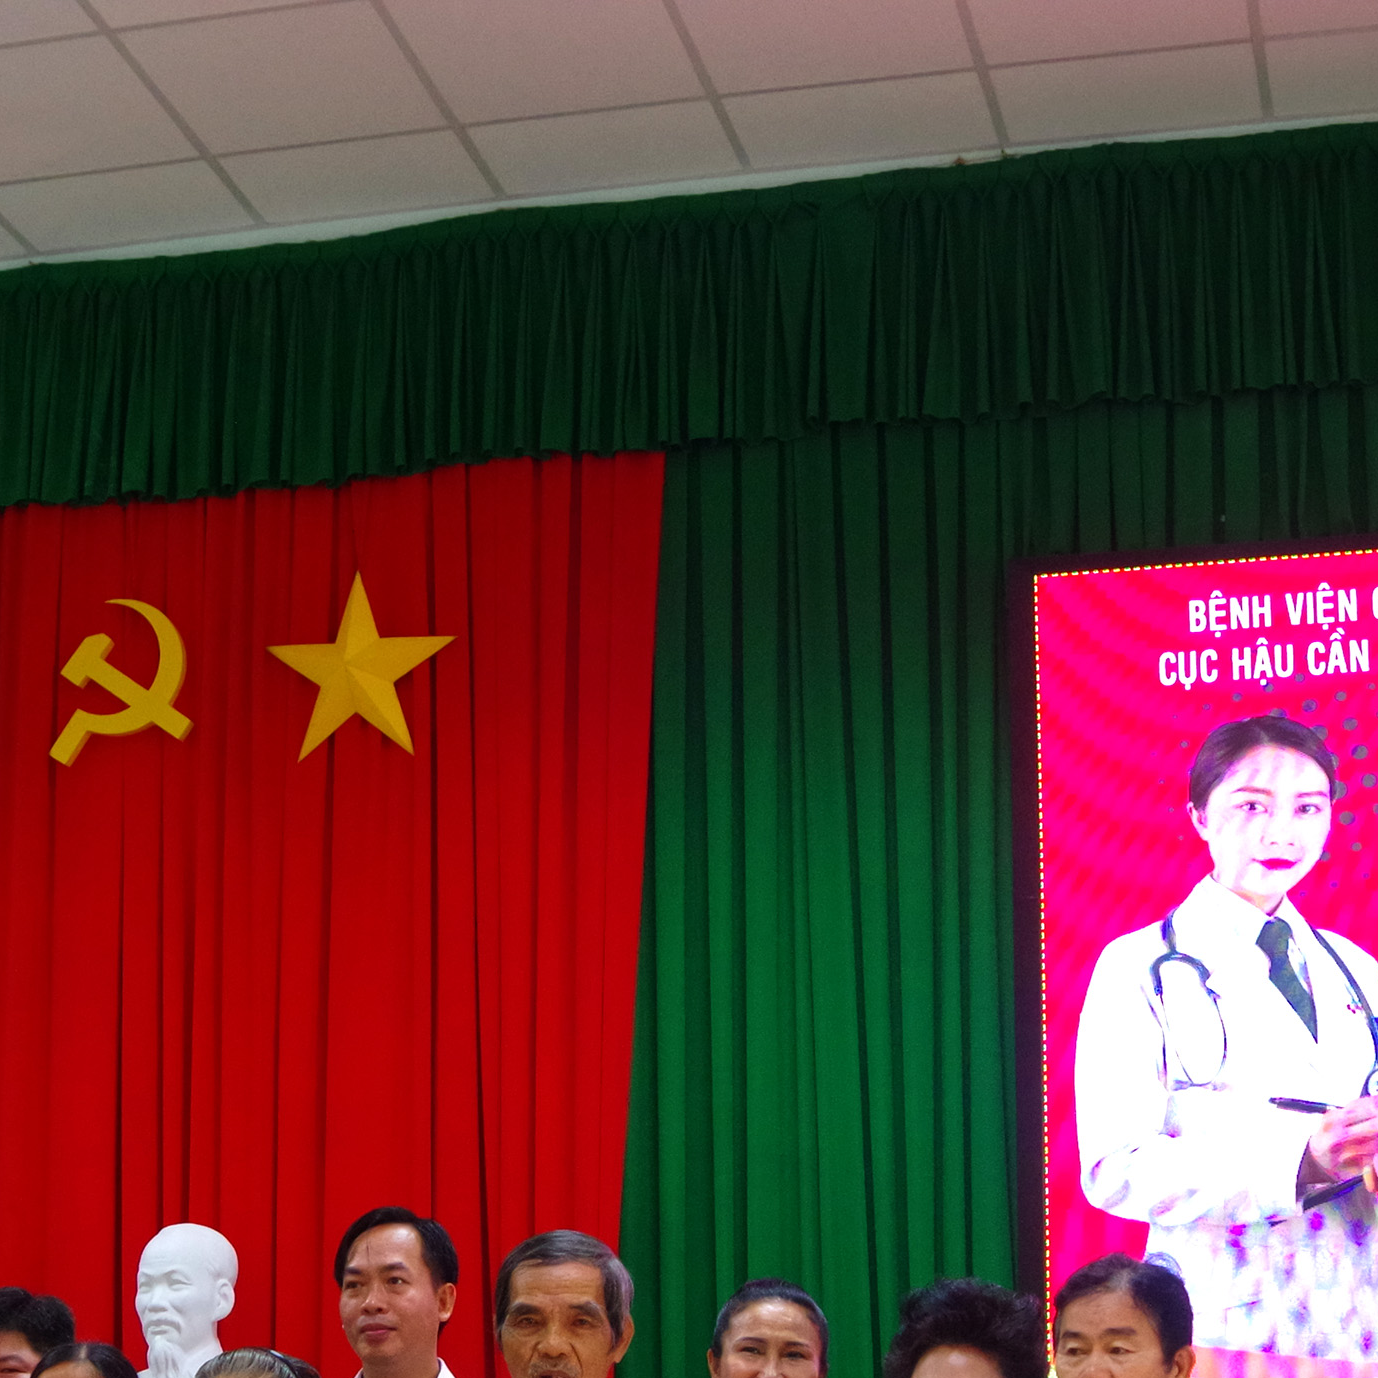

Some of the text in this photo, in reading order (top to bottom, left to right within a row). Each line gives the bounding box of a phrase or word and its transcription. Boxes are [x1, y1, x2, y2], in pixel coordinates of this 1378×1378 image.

[1189, 590, 1271, 638] BỆNH
[1286, 582, 1358, 630] VIỆN
[1159, 649, 1218, 690] CỤC
[1232, 637, 1294, 686] HẬU
[1307, 627, 1369, 676] CẦN
